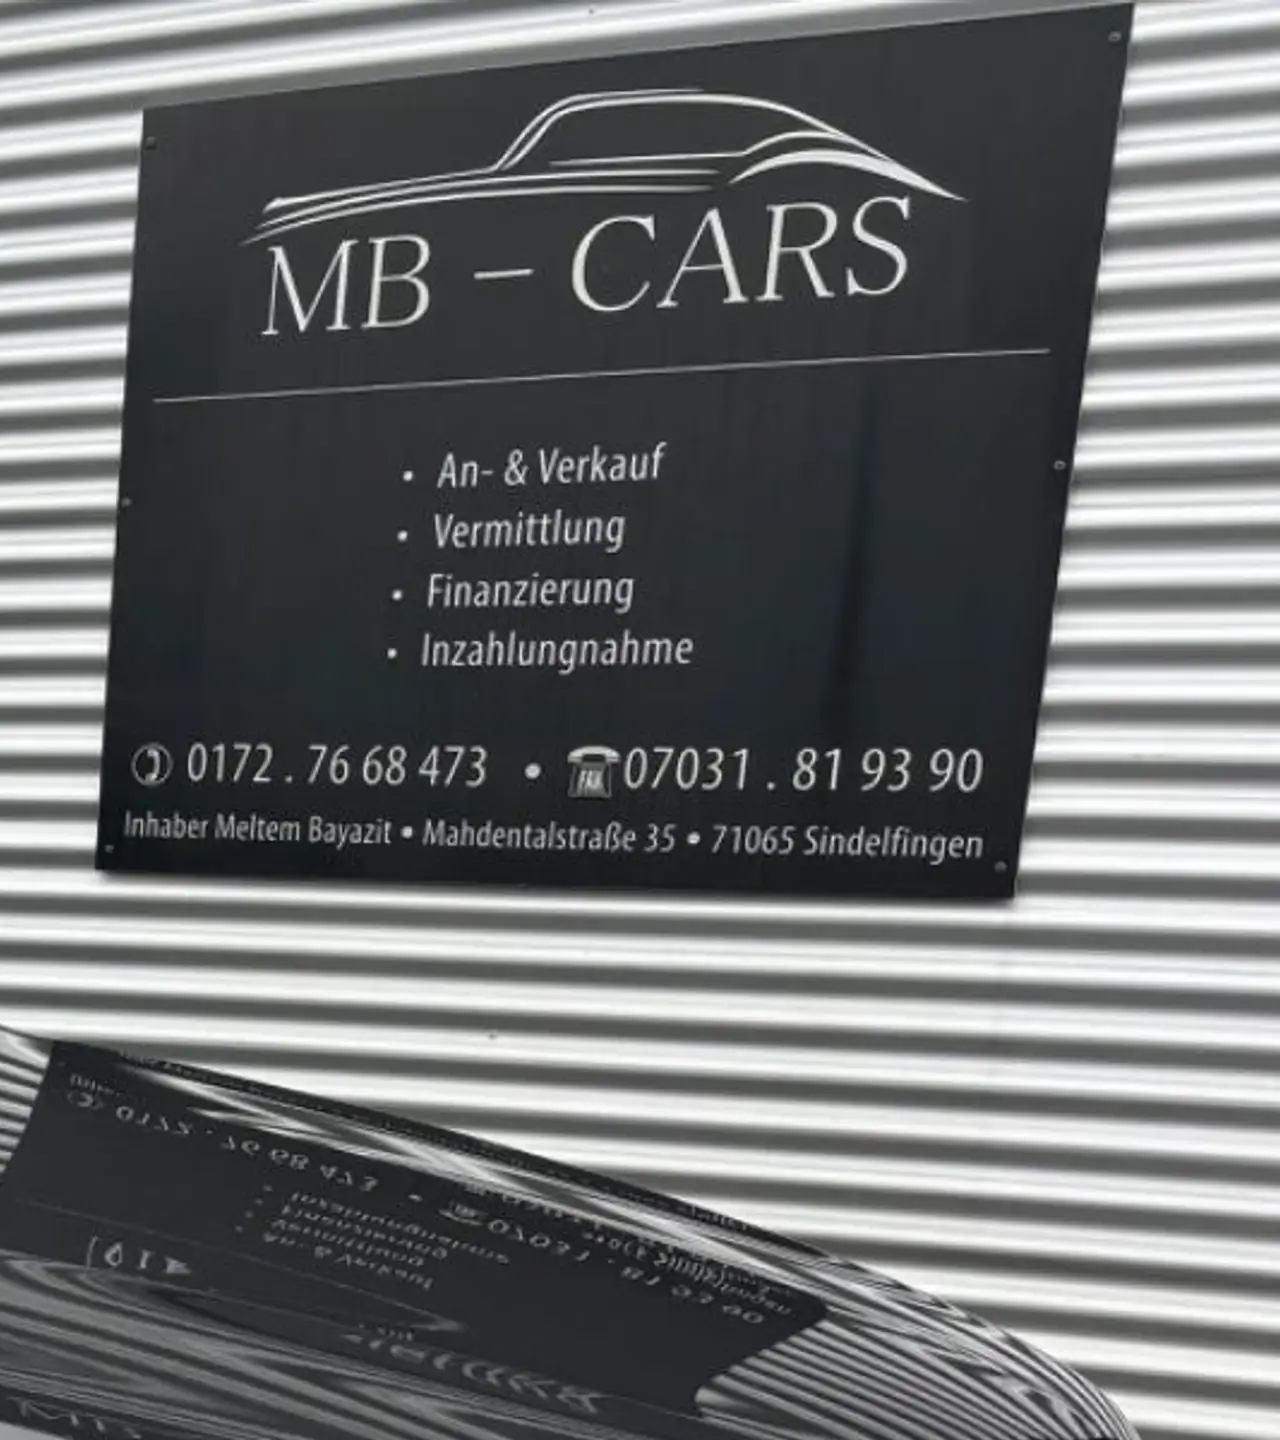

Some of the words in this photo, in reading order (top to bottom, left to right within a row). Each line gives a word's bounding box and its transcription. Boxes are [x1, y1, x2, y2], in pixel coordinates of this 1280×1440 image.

[261, 232, 431, 338] MB
[569, 194, 912, 314] CARS
[437, 452, 494, 488] An-
[503, 450, 528, 487] &
[538, 442, 668, 486] Verkauf
[433, 508, 626, 553] Vermittlung
[426, 571, 635, 614] Finanzierung
[420, 628, 695, 675] Inzahlungnahme
[187, 743, 274, 784] 0172
[307, 744, 351, 785] 76
[361, 744, 408, 786] 68
[418, 744, 488, 788] 473
[623, 747, 750, 791] 07031
[791, 747, 842, 792] 81
[860, 747, 913, 792] 93
[929, 747, 985, 793] 90
[124, 811, 209, 840] Inhaber
[214, 813, 301, 843] Meltem
[308, 815, 392, 850] Bayazit
[422, 819, 637, 853] Mahdentalstraße
[643, 823, 677, 854] 35
[711, 825, 796, 856] 71065
[801, 825, 985, 865] Sindelfingen
